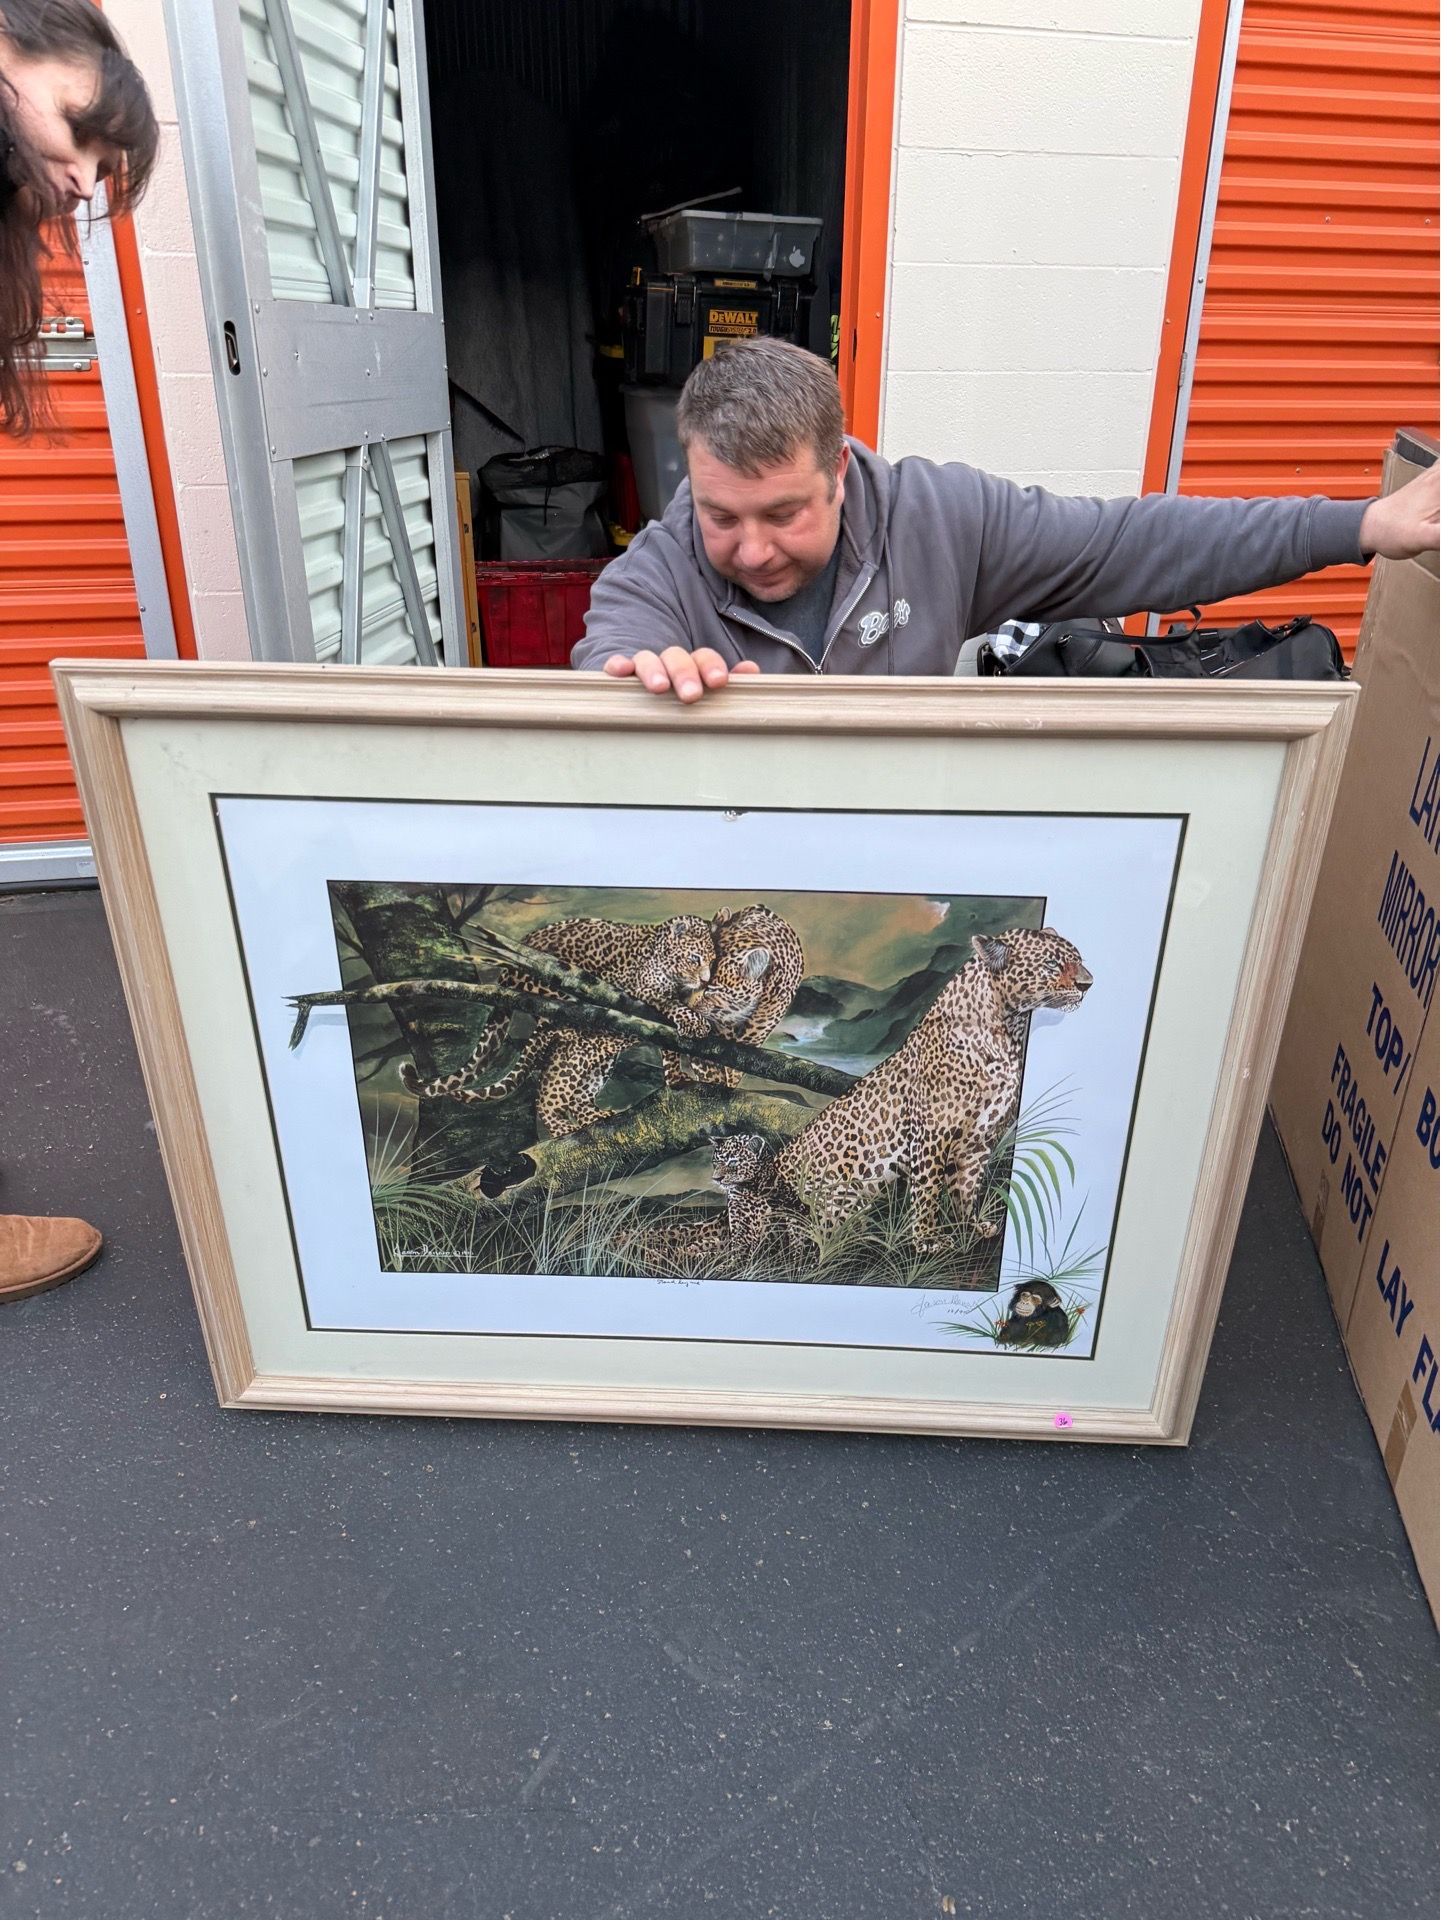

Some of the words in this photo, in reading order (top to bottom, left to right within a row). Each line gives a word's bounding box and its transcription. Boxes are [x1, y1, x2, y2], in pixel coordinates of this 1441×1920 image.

[1409, 736, 1440, 855] LA
[1331, 1042, 1387, 1195] FRAGILE
[1321, 1099, 1341, 1164] DO
[1341, 1152, 1373, 1244] NOT
[1376, 1239, 1414, 1338] LAY
